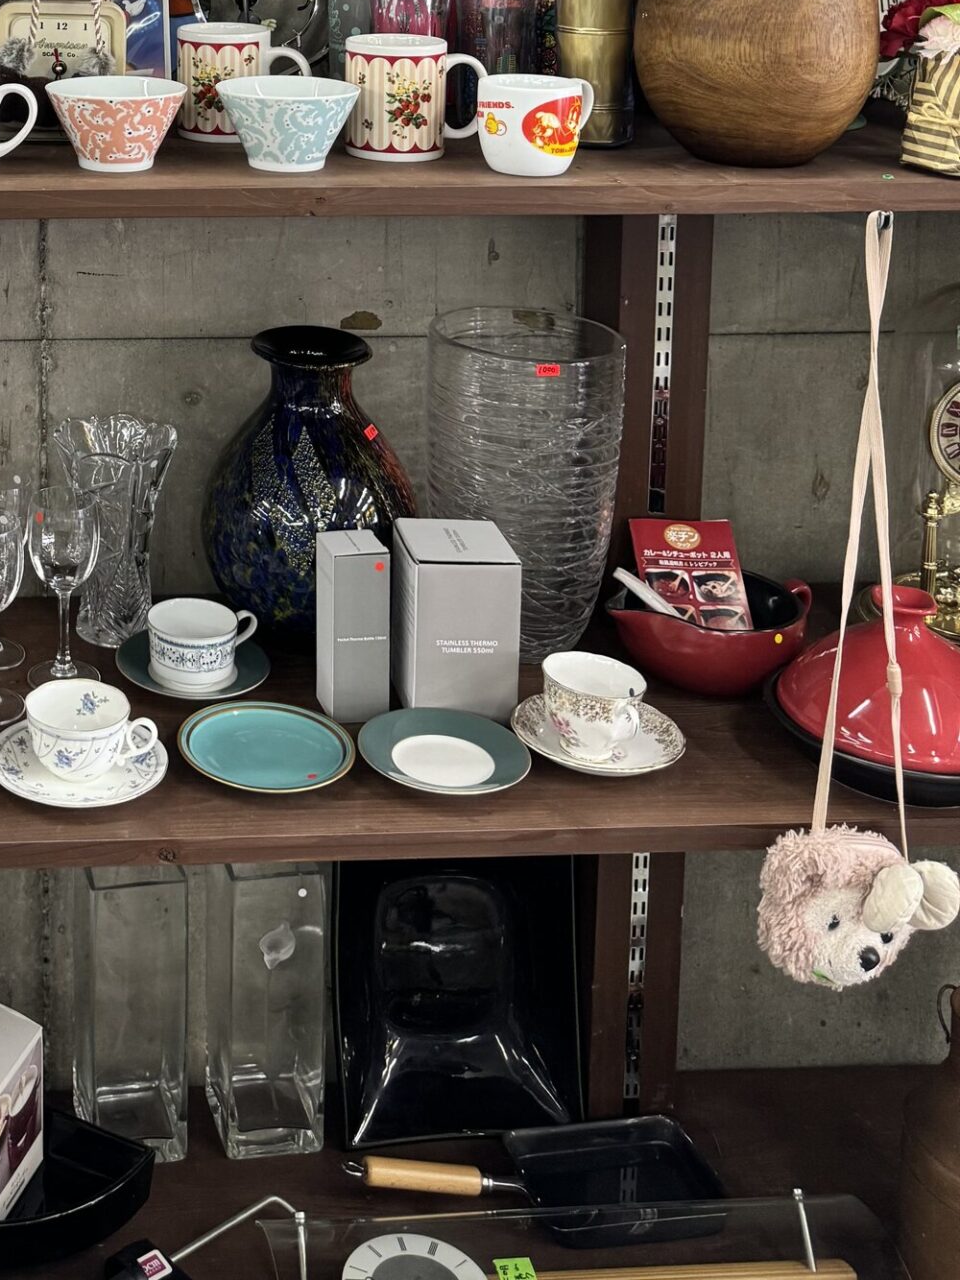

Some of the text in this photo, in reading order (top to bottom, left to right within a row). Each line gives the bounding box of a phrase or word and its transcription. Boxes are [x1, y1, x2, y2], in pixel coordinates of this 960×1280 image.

[56, 22, 68, 31] 12
[435, 639, 499, 647] STAINLESS THERMO
[441, 646, 472, 654] TUMBLER
